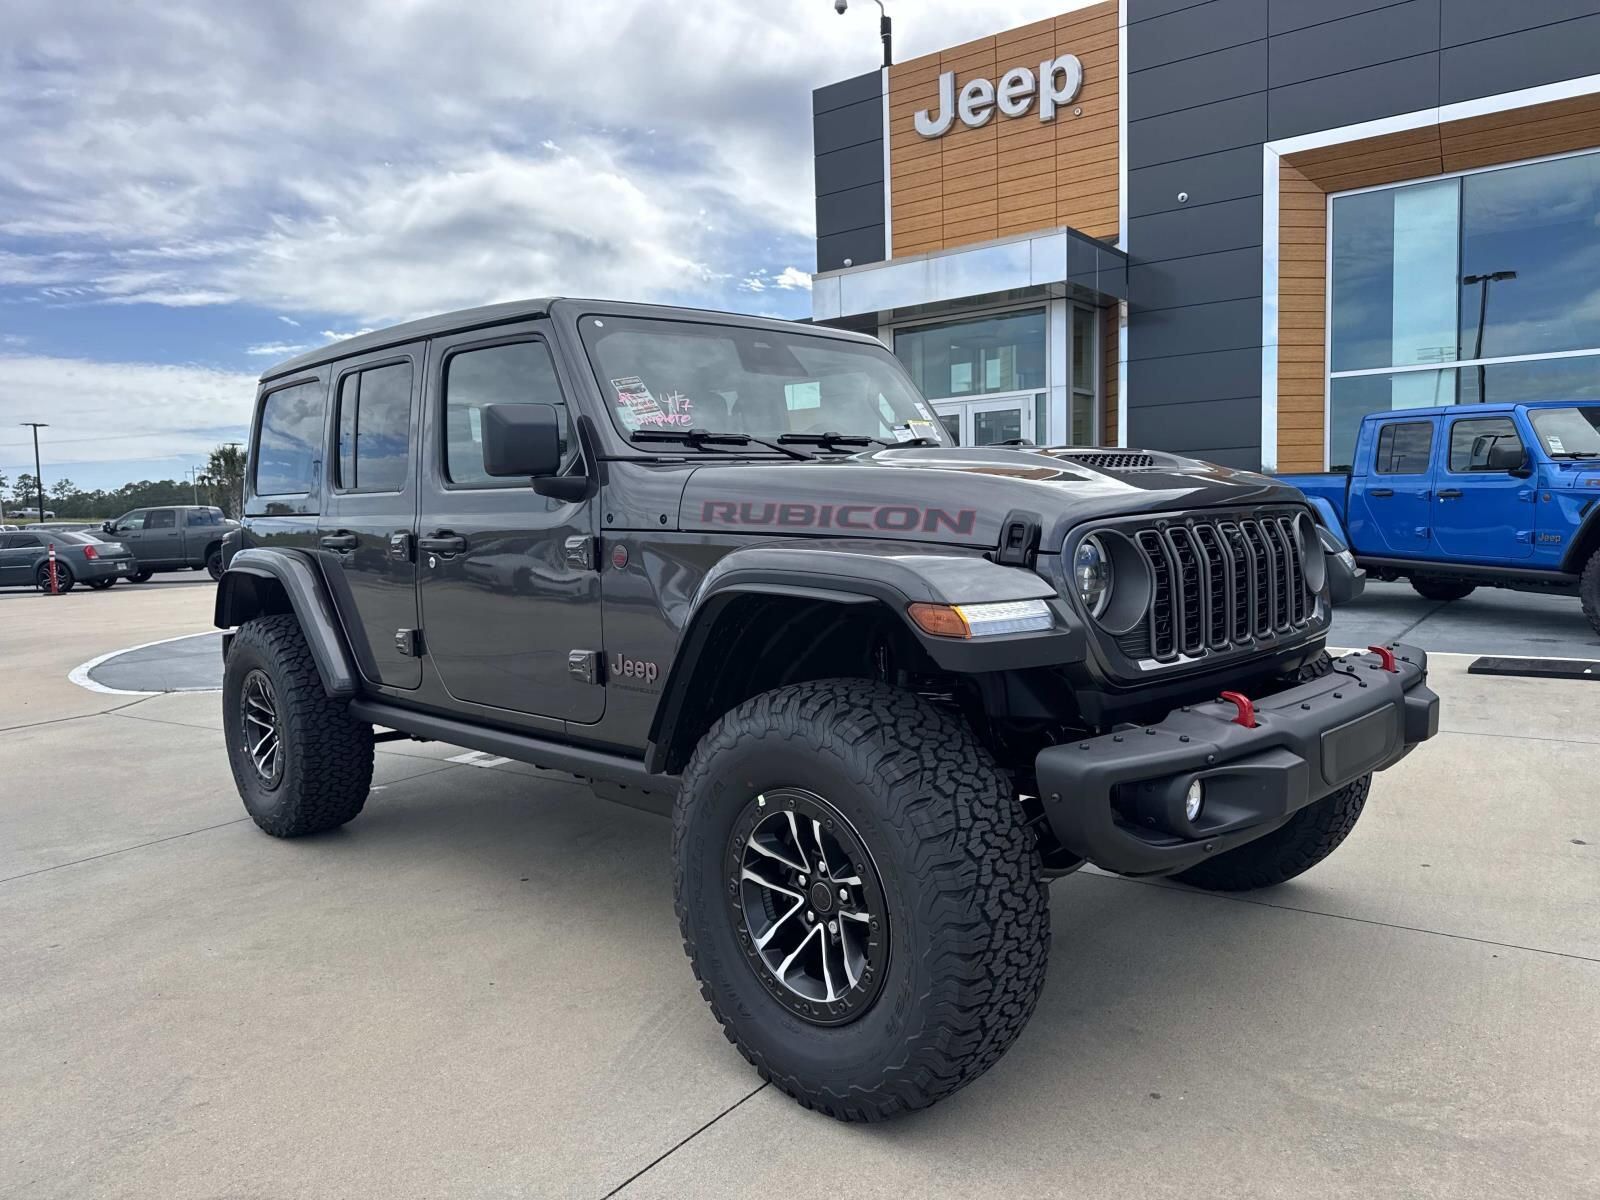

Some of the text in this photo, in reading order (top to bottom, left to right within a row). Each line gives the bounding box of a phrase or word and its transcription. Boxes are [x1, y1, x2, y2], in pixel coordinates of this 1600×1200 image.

[914, 53, 1083, 139] Jeep
[702, 502, 976, 535] RUBICON
[1538, 532, 1562, 543] Jeep
[611, 653, 659, 684] Jeep
